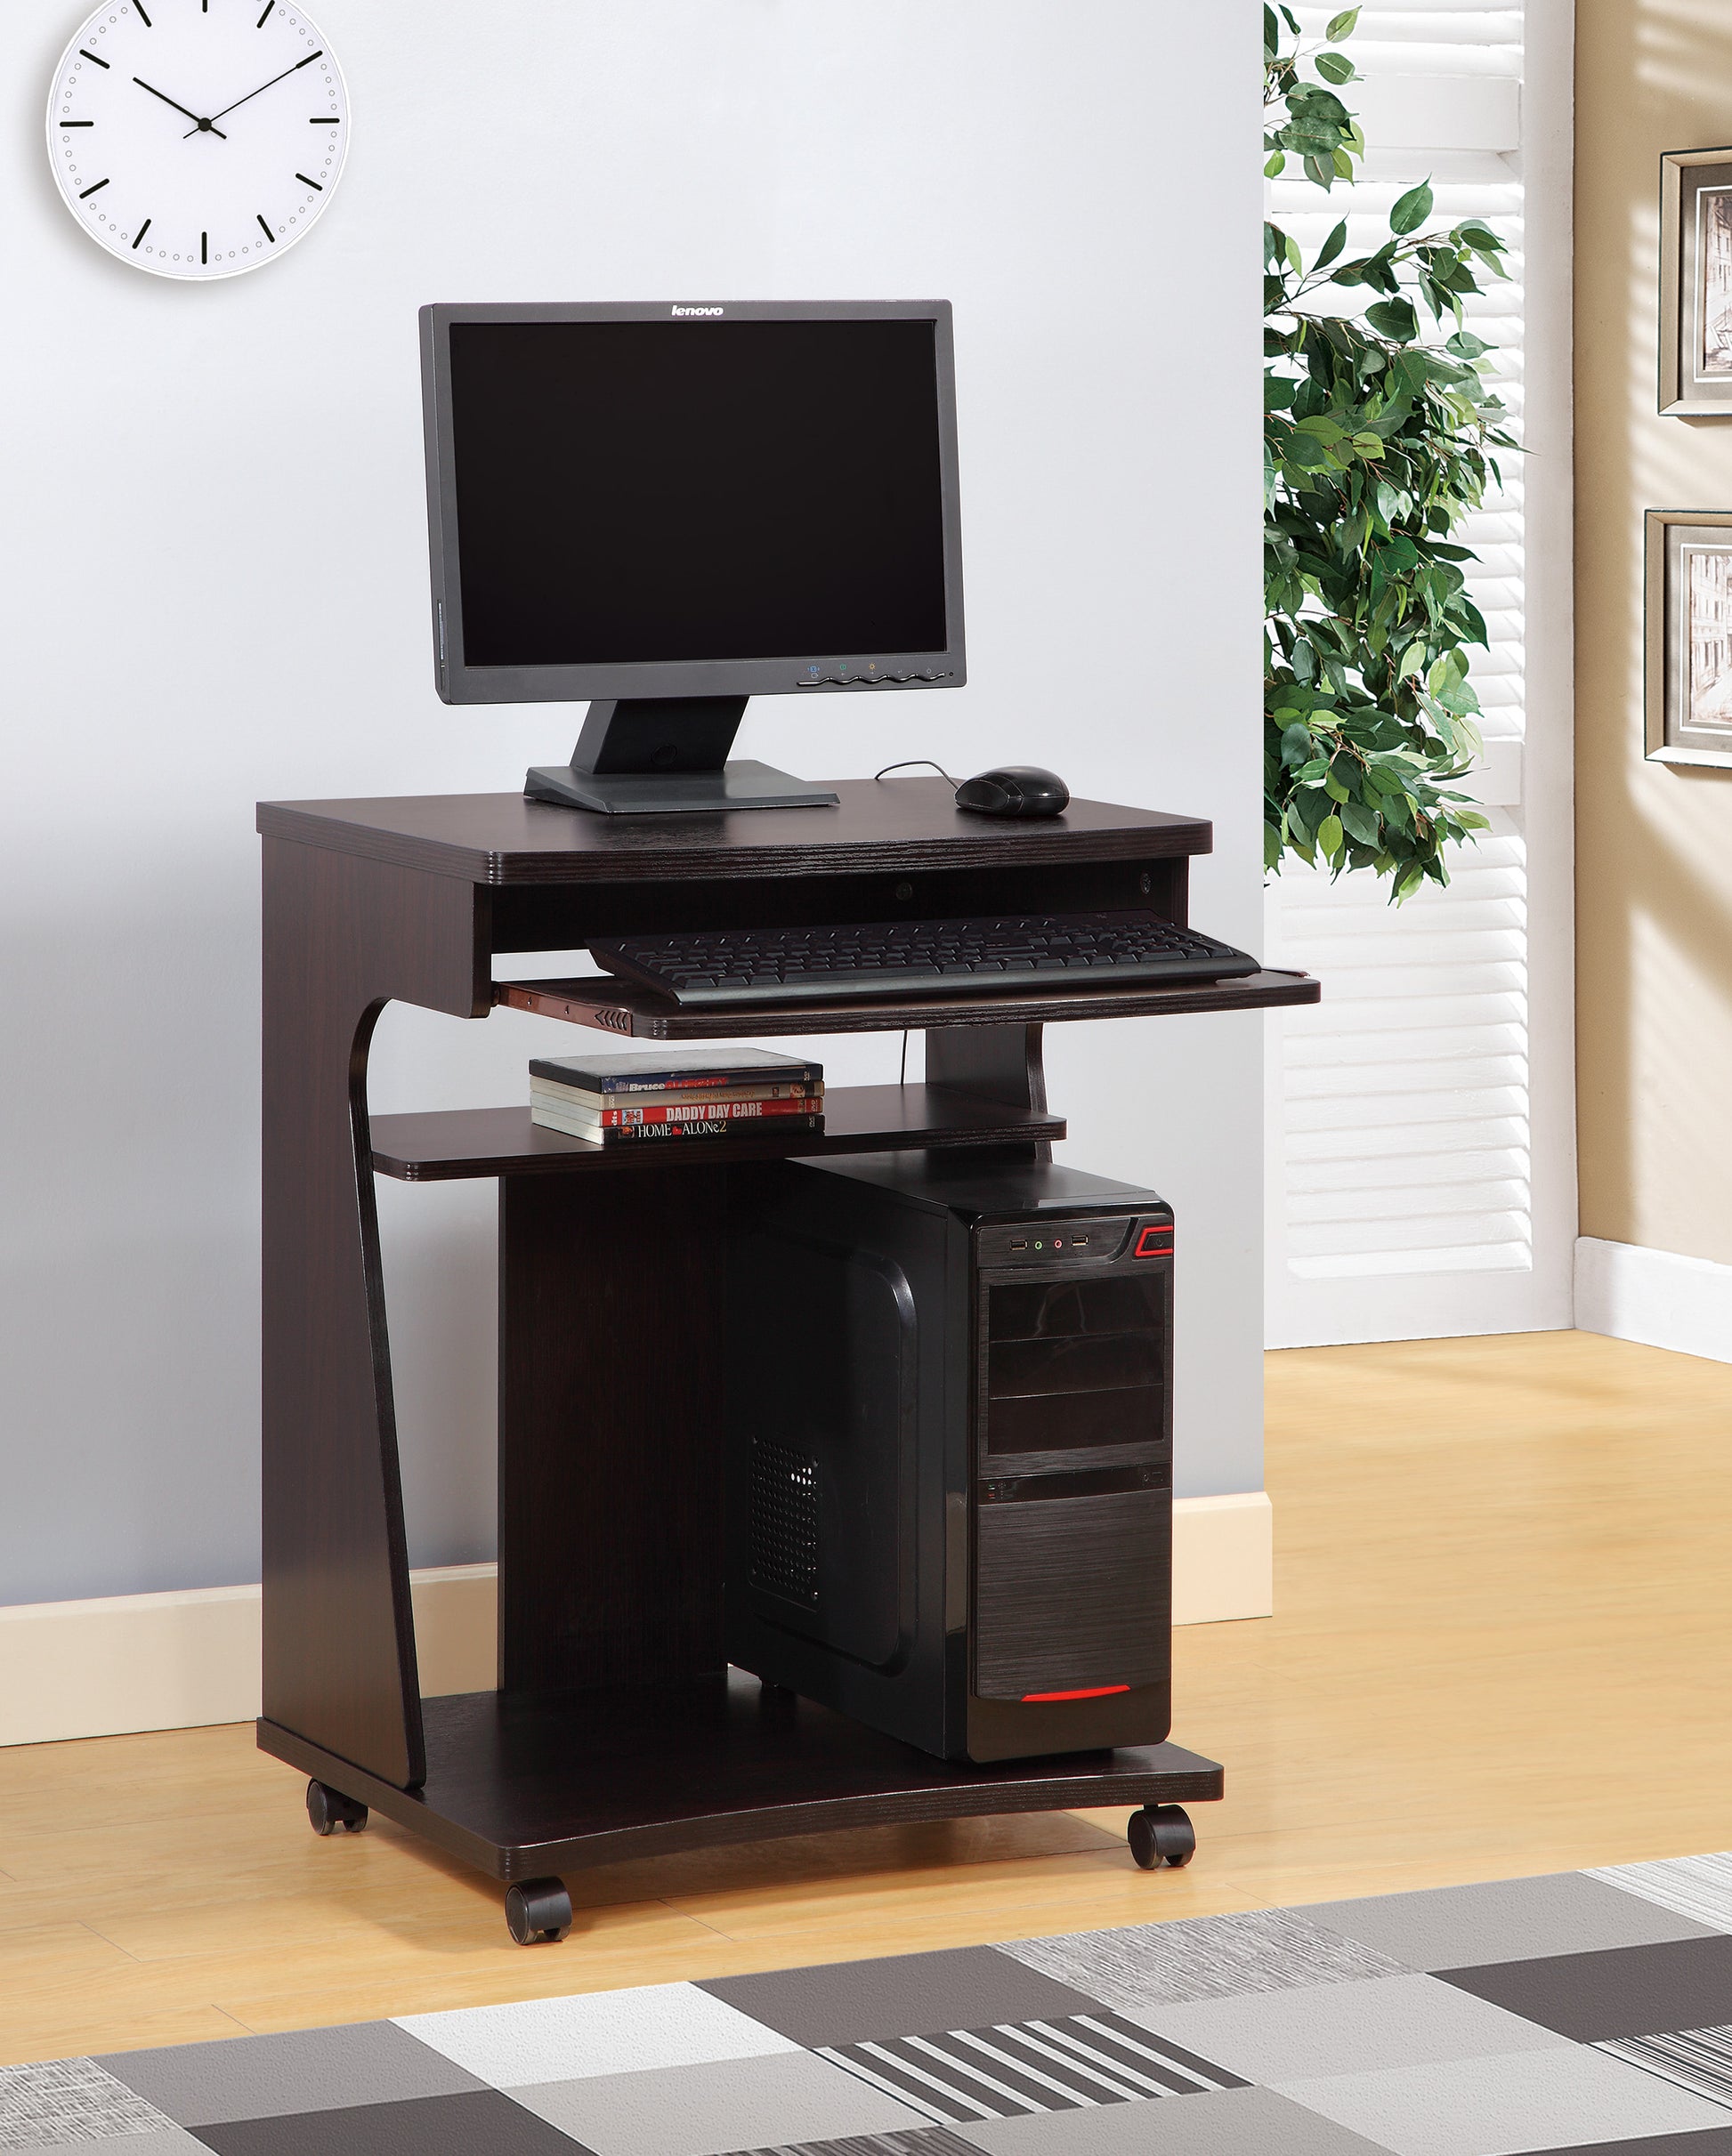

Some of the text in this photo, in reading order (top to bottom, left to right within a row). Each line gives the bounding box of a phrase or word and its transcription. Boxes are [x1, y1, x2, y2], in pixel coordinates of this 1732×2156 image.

[671, 305, 724, 316] lenovo
[629, 1082, 665, 1092] Bruce
[666, 1102, 762, 1122] DADDY DAY CARE
[638, 1124, 672, 1138] HOME
